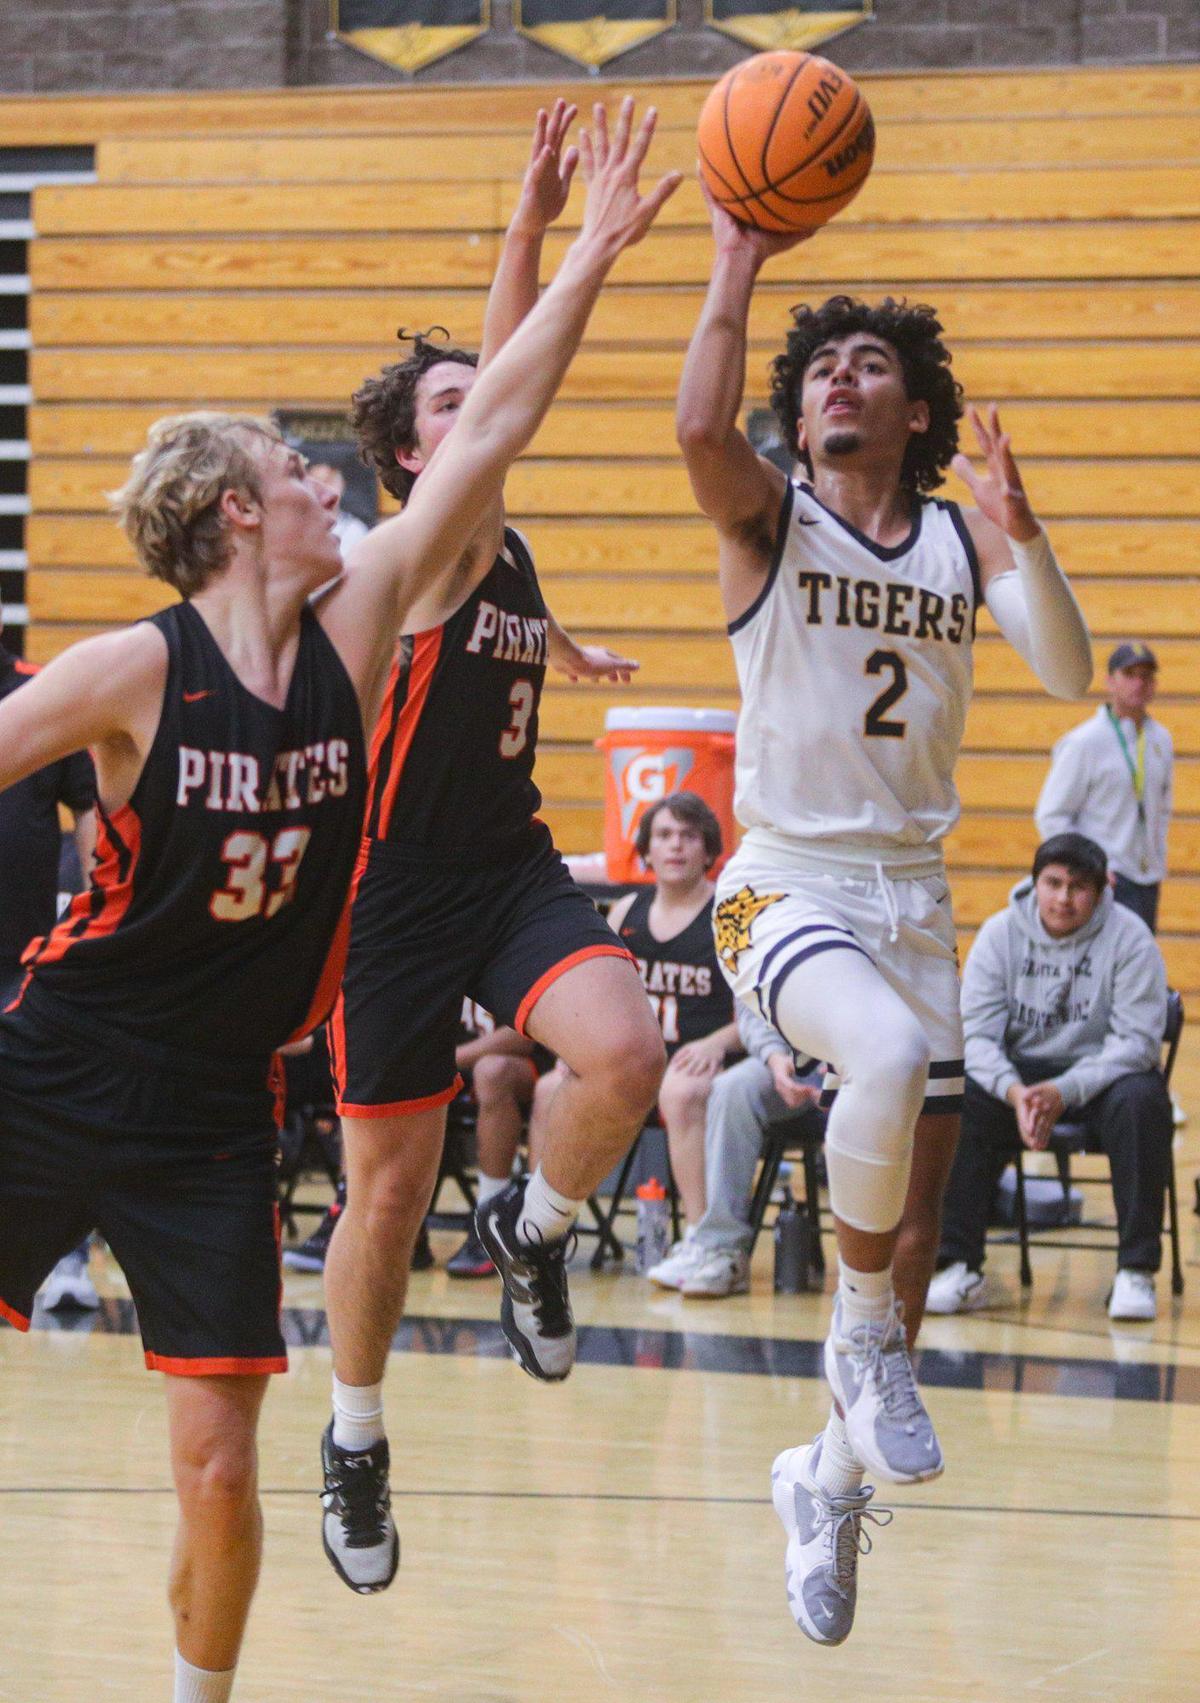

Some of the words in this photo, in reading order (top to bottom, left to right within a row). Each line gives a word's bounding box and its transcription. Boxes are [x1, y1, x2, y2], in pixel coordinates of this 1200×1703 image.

[798, 571, 968, 644] TIGERS
[498, 679, 535, 760] 3
[864, 650, 908, 739] 2
[626, 755, 666, 801] G
